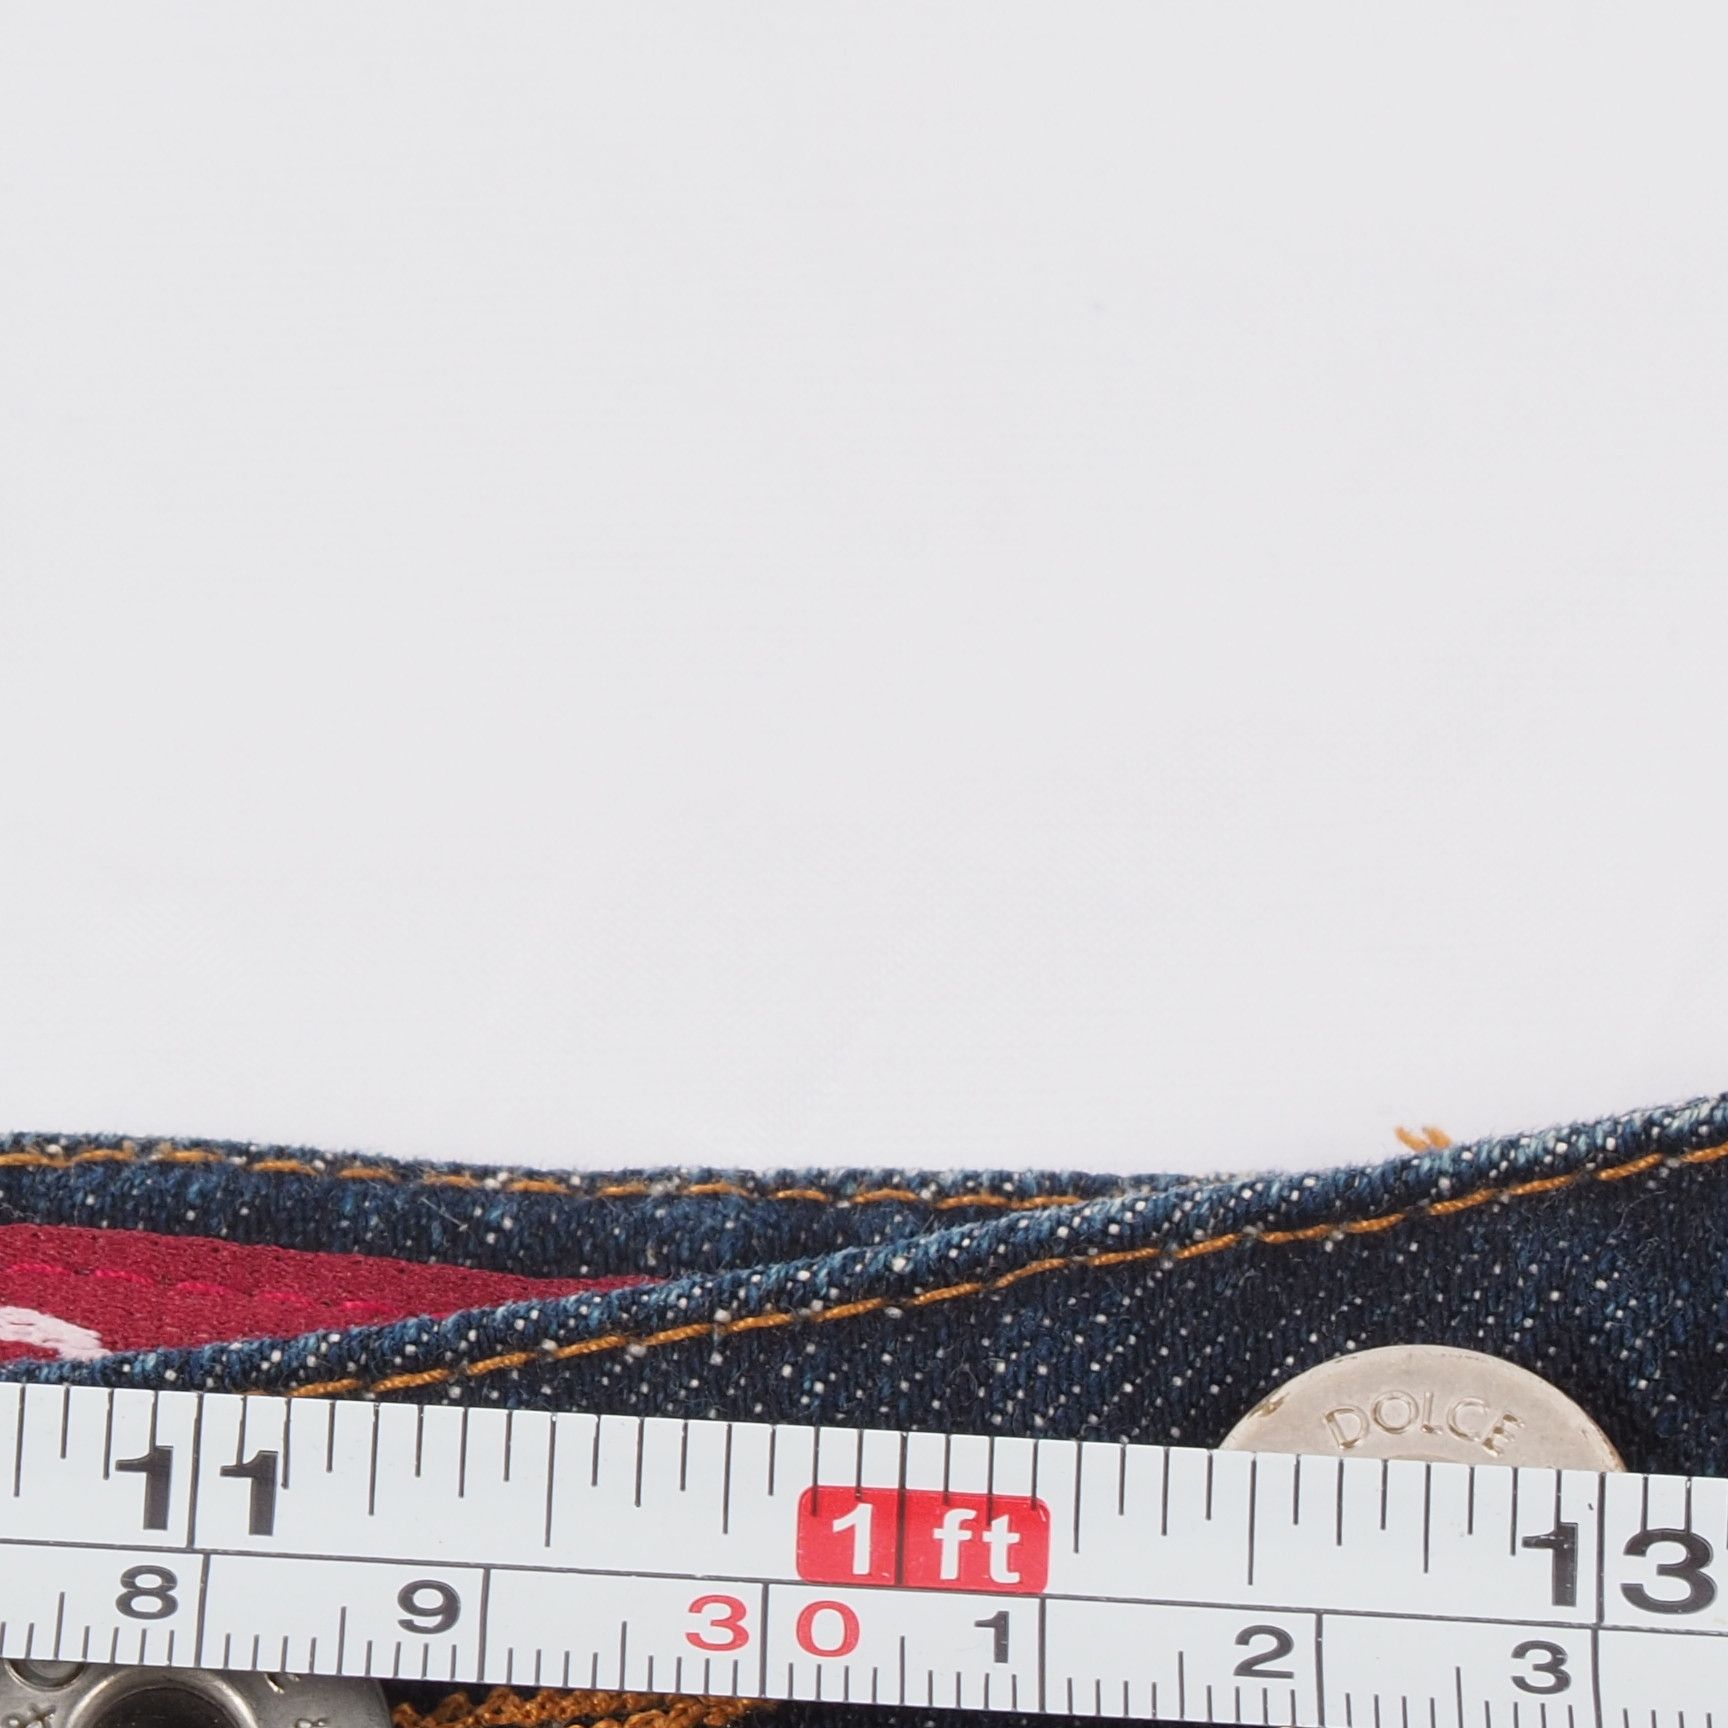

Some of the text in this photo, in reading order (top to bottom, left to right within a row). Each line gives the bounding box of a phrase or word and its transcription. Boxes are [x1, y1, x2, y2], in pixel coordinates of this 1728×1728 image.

[1322, 1389, 1526, 1458] DOLCE
[115, 1445, 279, 1537] 11
[832, 1502, 1021, 1584] 1 ft
[1521, 1521, 1718, 1615] 13
[115, 1565, 180, 1620] 8
[397, 1579, 462, 1635] 9
[684, 1593, 861, 1658] 30
[974, 1609, 1009, 1664] 1
[1232, 1624, 1296, 1680] 2
[1510, 1639, 1573, 1695] 3
